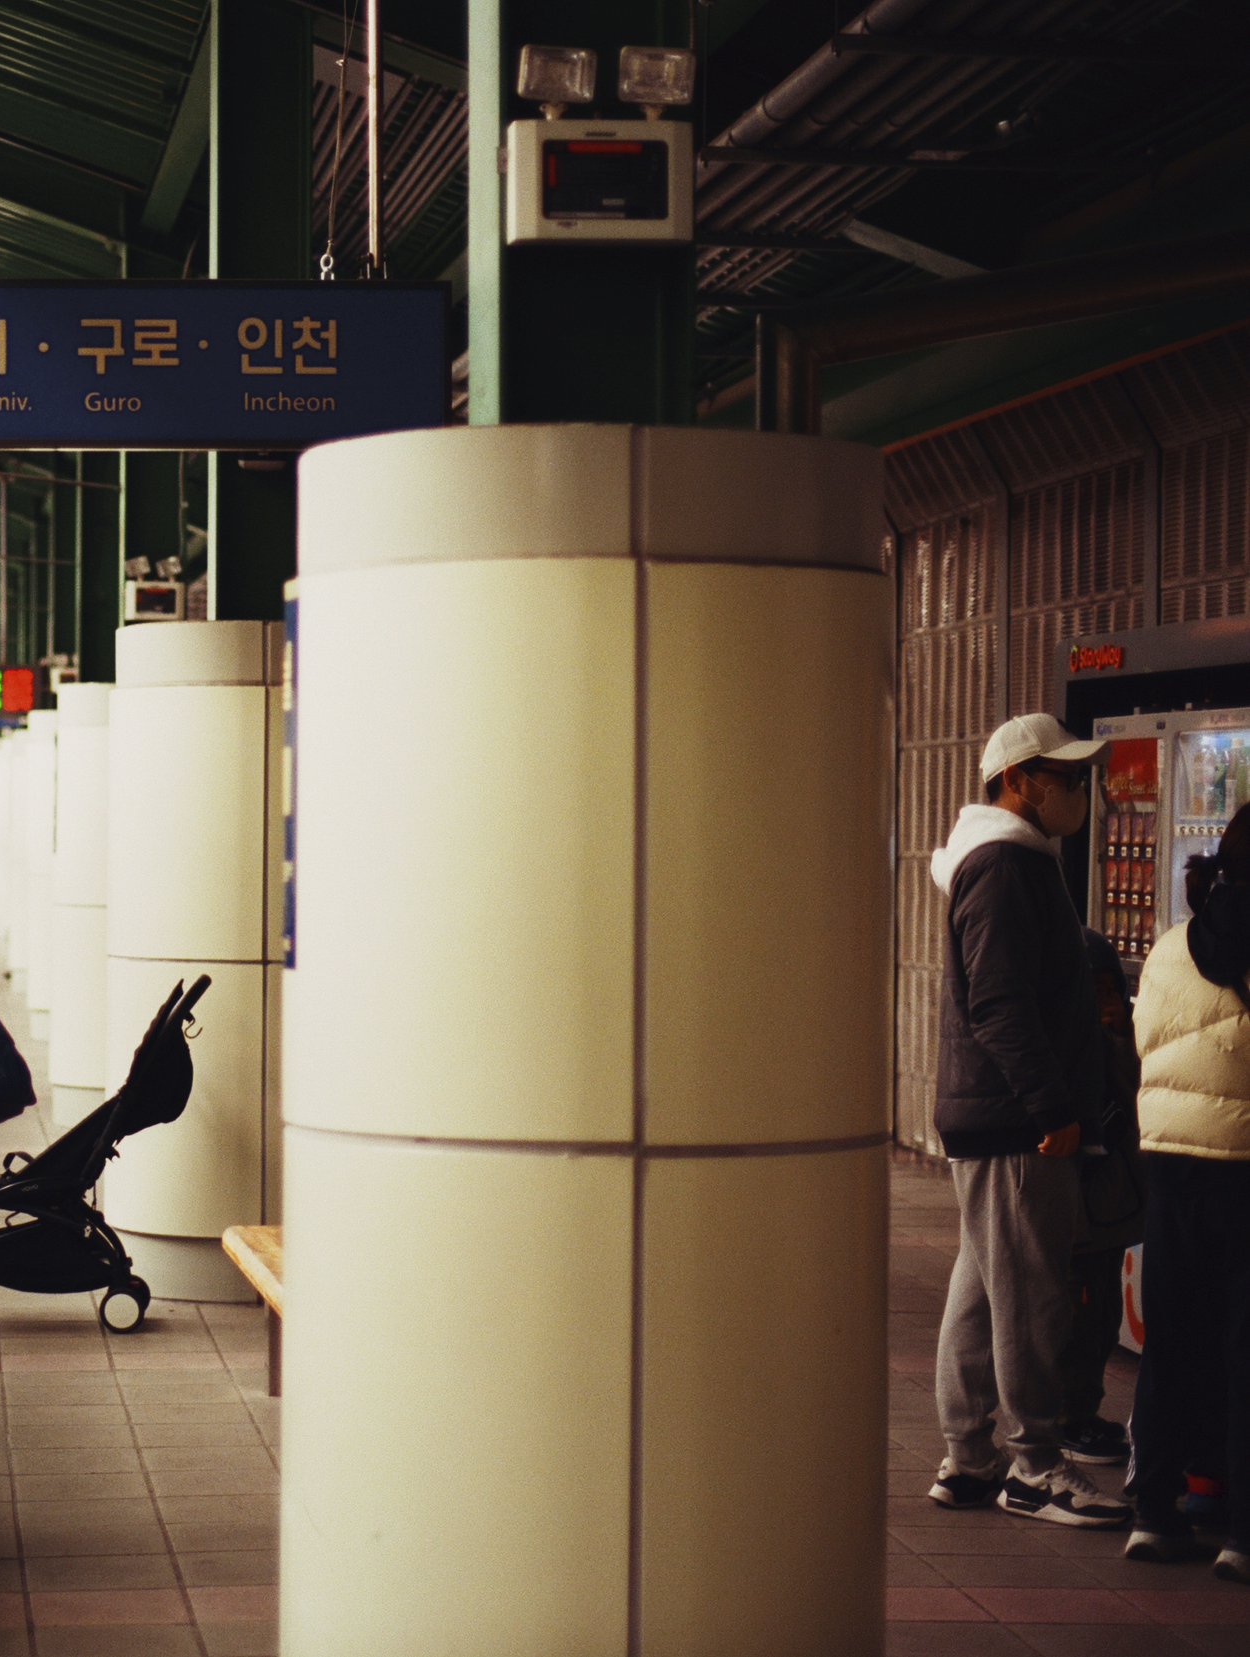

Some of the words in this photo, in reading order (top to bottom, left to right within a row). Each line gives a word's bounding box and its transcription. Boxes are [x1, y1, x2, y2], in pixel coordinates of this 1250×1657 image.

[76, 317, 180, 375] 구로
[237, 316, 338, 375] 인천
[84, 391, 142, 413] Guro
[243, 390, 337, 413] Incheon
